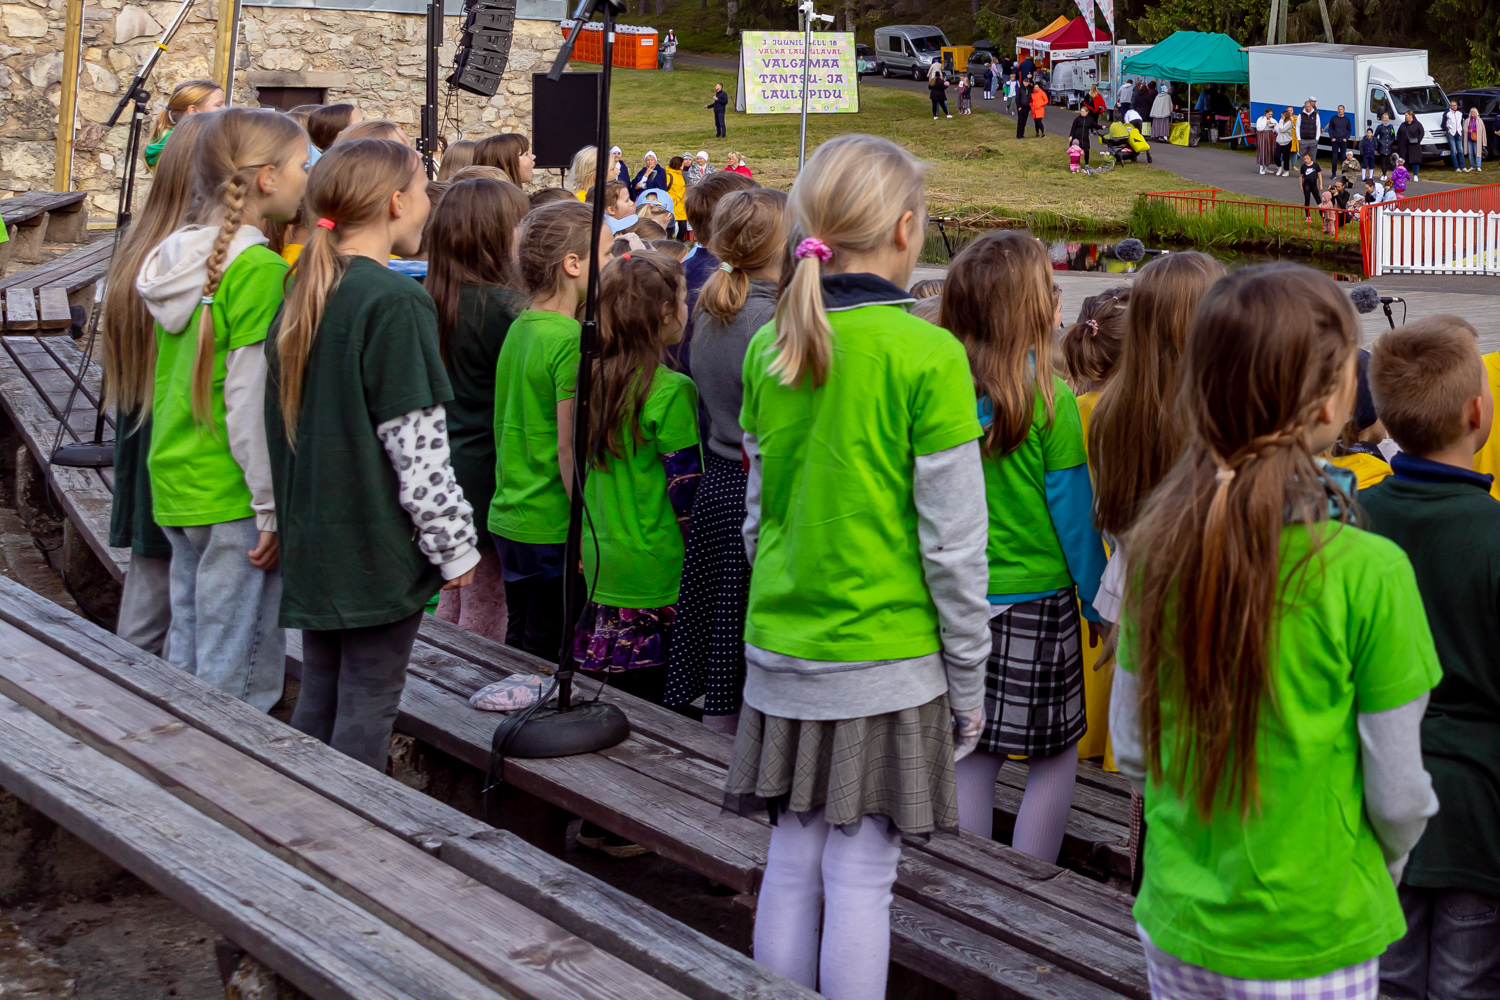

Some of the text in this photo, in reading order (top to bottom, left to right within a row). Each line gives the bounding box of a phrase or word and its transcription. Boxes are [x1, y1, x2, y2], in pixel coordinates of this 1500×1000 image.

[761, 58, 840, 69] VALGAMAA
[758, 73, 844, 84] TANTSU- JA
[761, 89, 843, 100] LAULUPIDU
